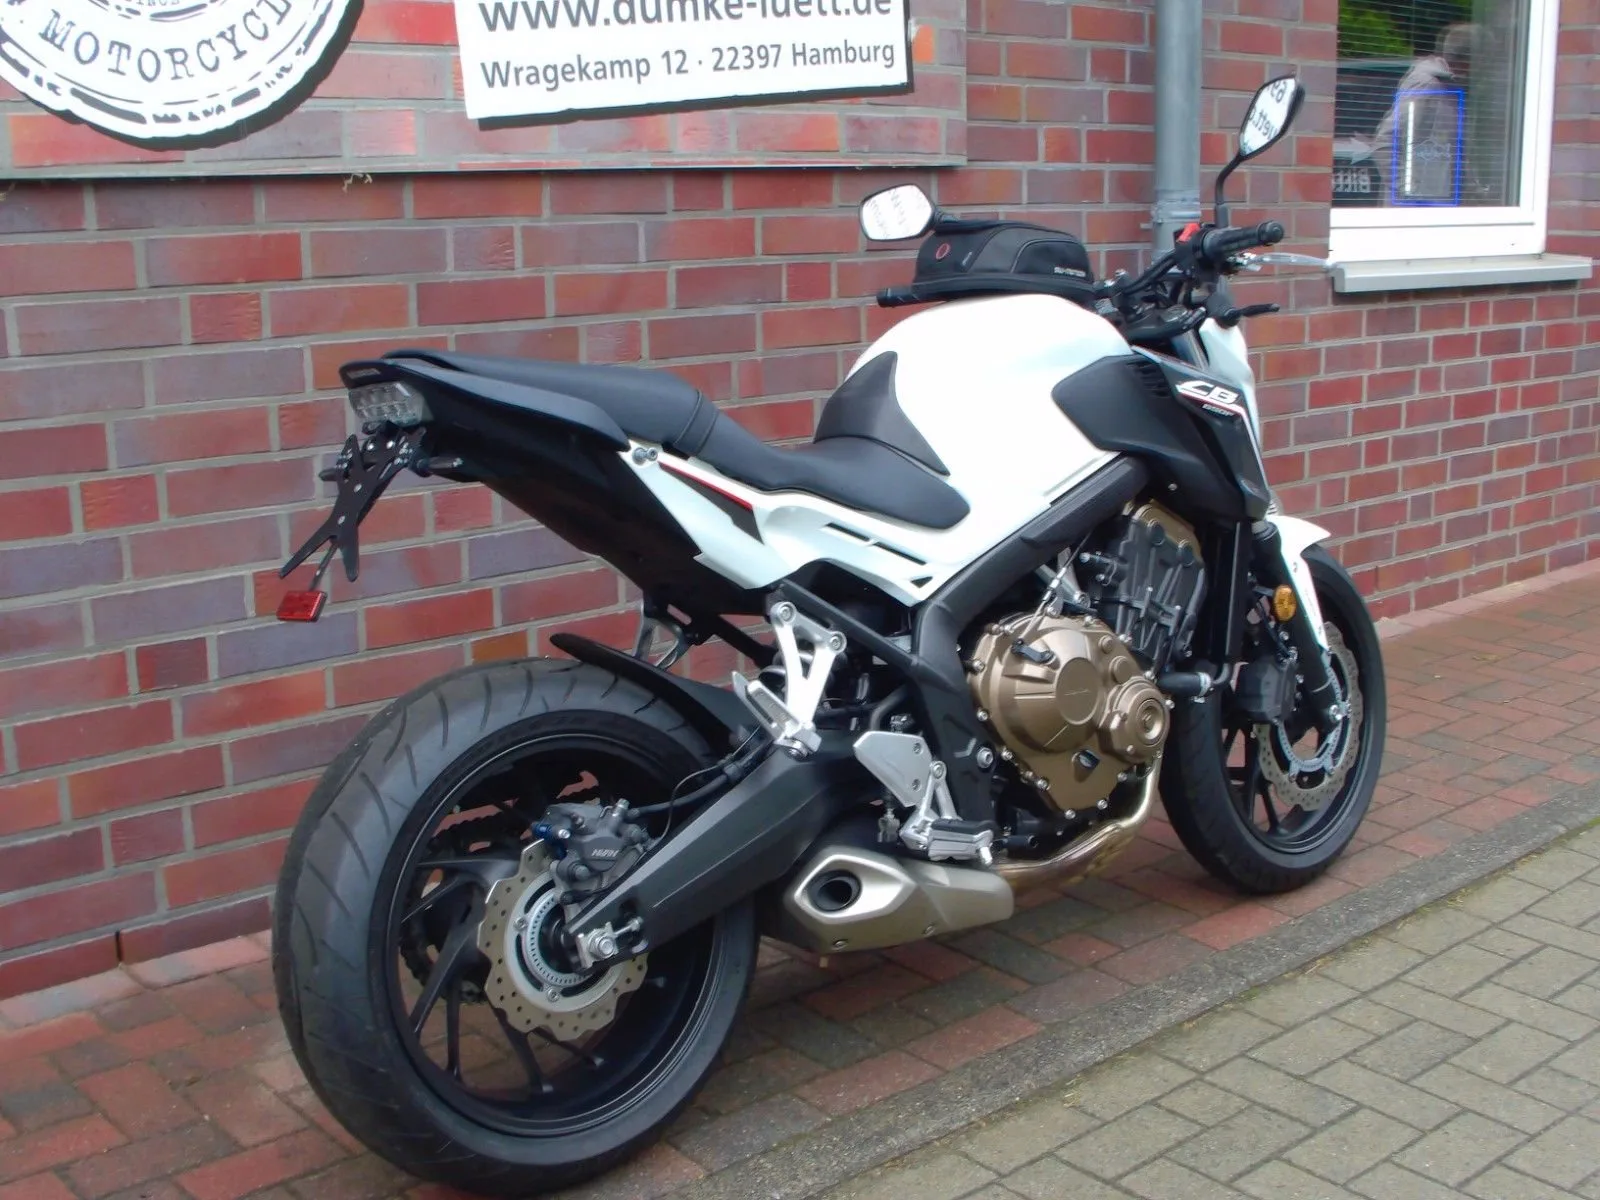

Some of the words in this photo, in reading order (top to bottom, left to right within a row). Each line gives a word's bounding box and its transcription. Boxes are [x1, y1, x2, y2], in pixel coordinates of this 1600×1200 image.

[480, 55, 651, 91] Wragekamp
[661, 50, 689, 75] 12
[711, 44, 782, 72] 22397
[792, 40, 895, 68] Hamburg
